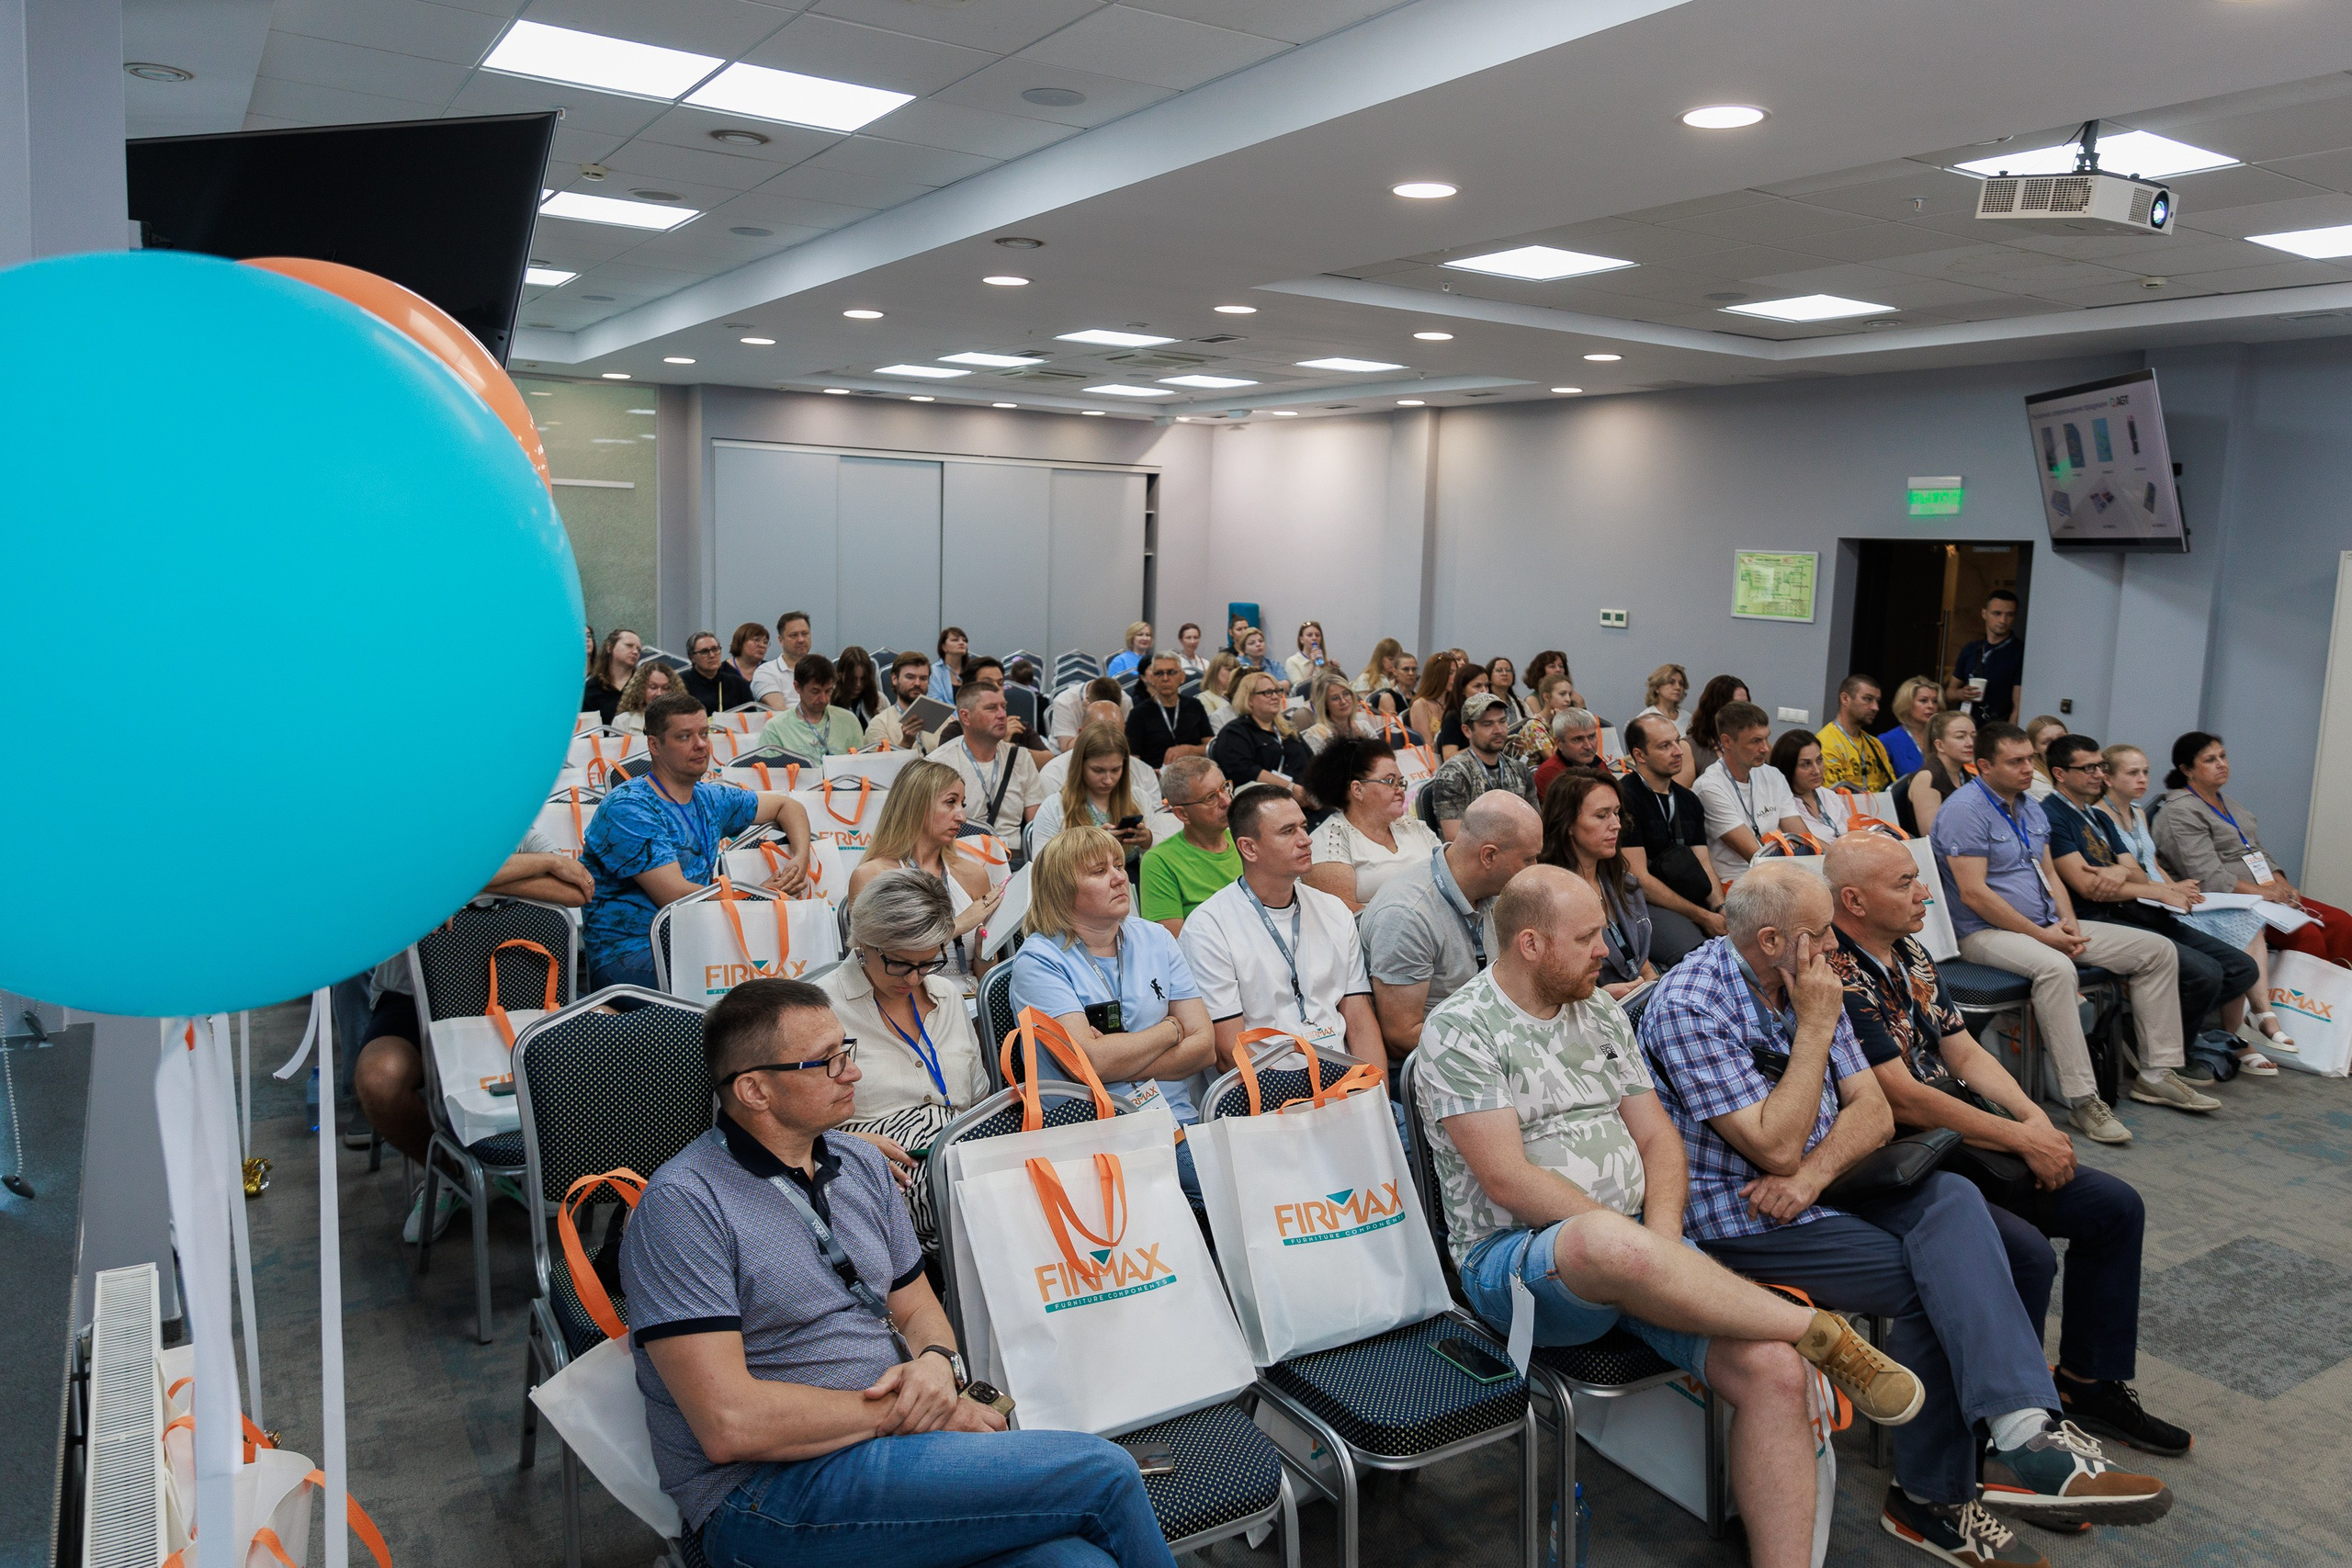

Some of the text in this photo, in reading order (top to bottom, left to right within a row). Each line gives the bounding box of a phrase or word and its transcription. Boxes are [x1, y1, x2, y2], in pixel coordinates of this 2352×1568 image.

[1131, 1086, 1159, 1106] RMAX
[1273, 1179, 1404, 1237] FIRMAX
[1291, 1232, 1340, 1245] FURNITURE
[1034, 1242, 1173, 1303] FIRMAX
[1055, 1278, 1168, 1310] FURNITURE COMPONENTS
